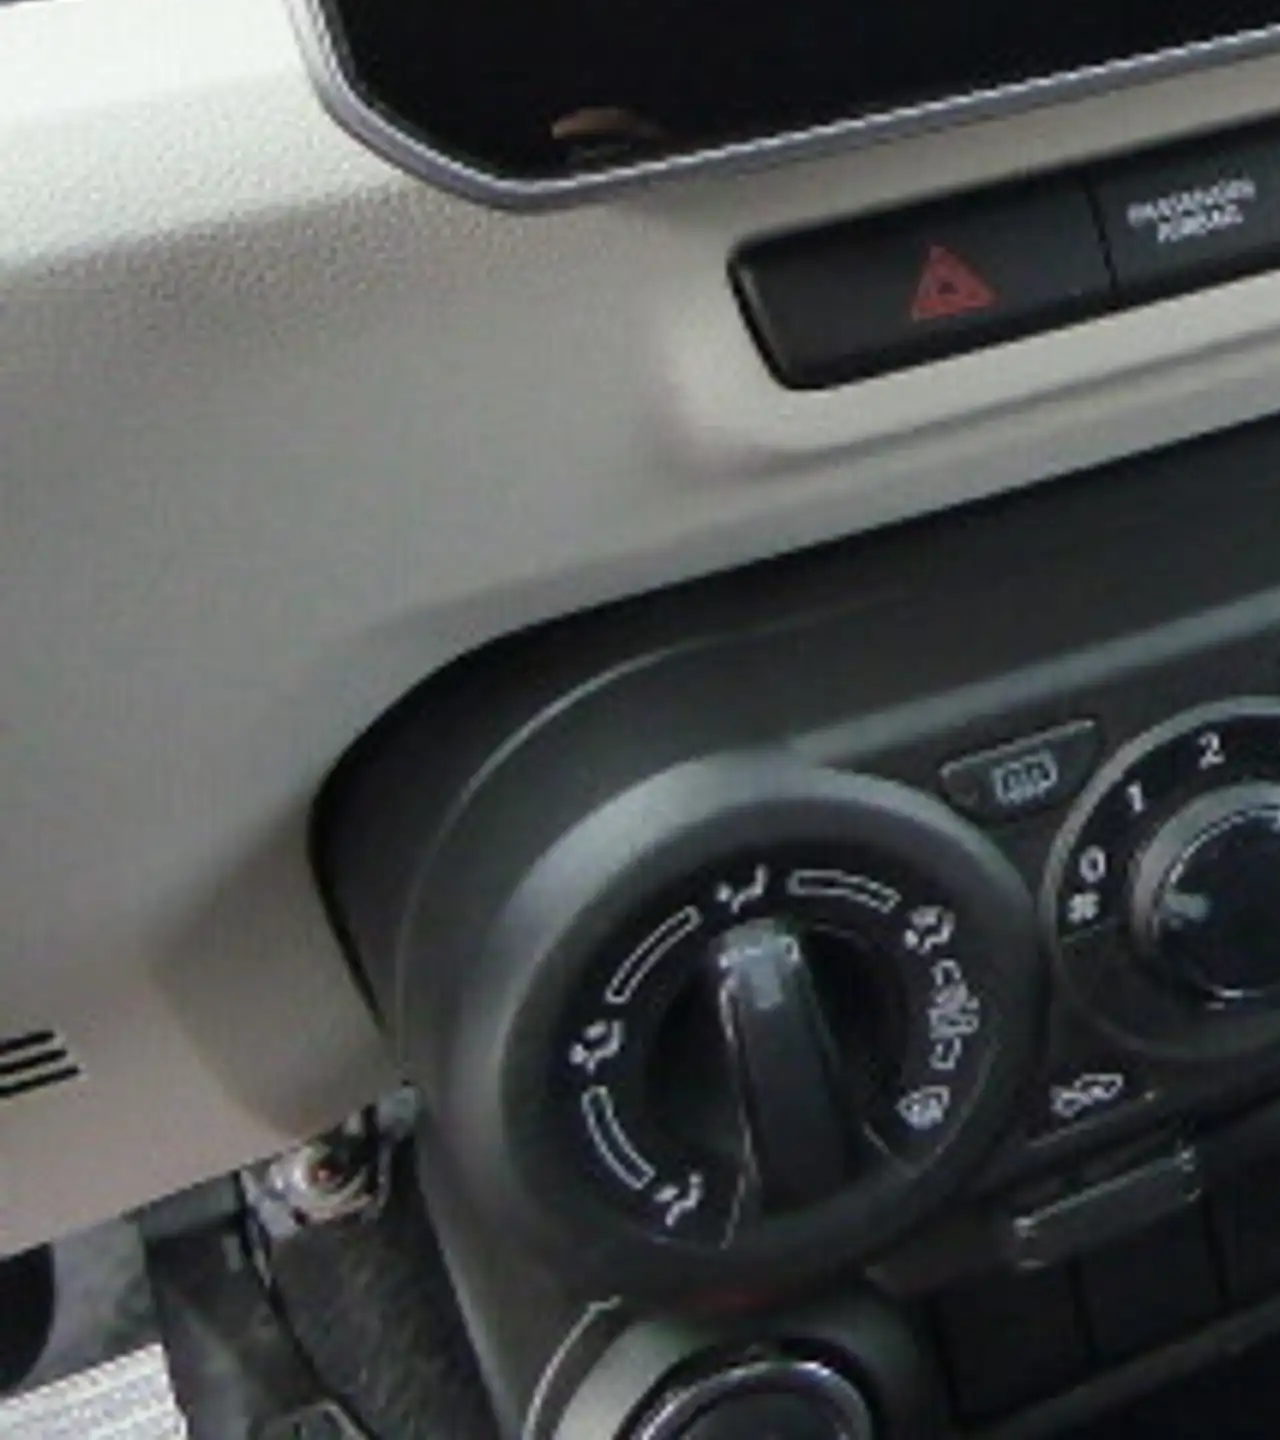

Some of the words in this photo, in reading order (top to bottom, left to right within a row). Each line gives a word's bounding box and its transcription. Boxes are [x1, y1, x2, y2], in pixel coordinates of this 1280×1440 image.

[1078, 845, 1107, 883] 0
[1126, 780, 1146, 815] 1
[1198, 731, 1226, 769] 2
